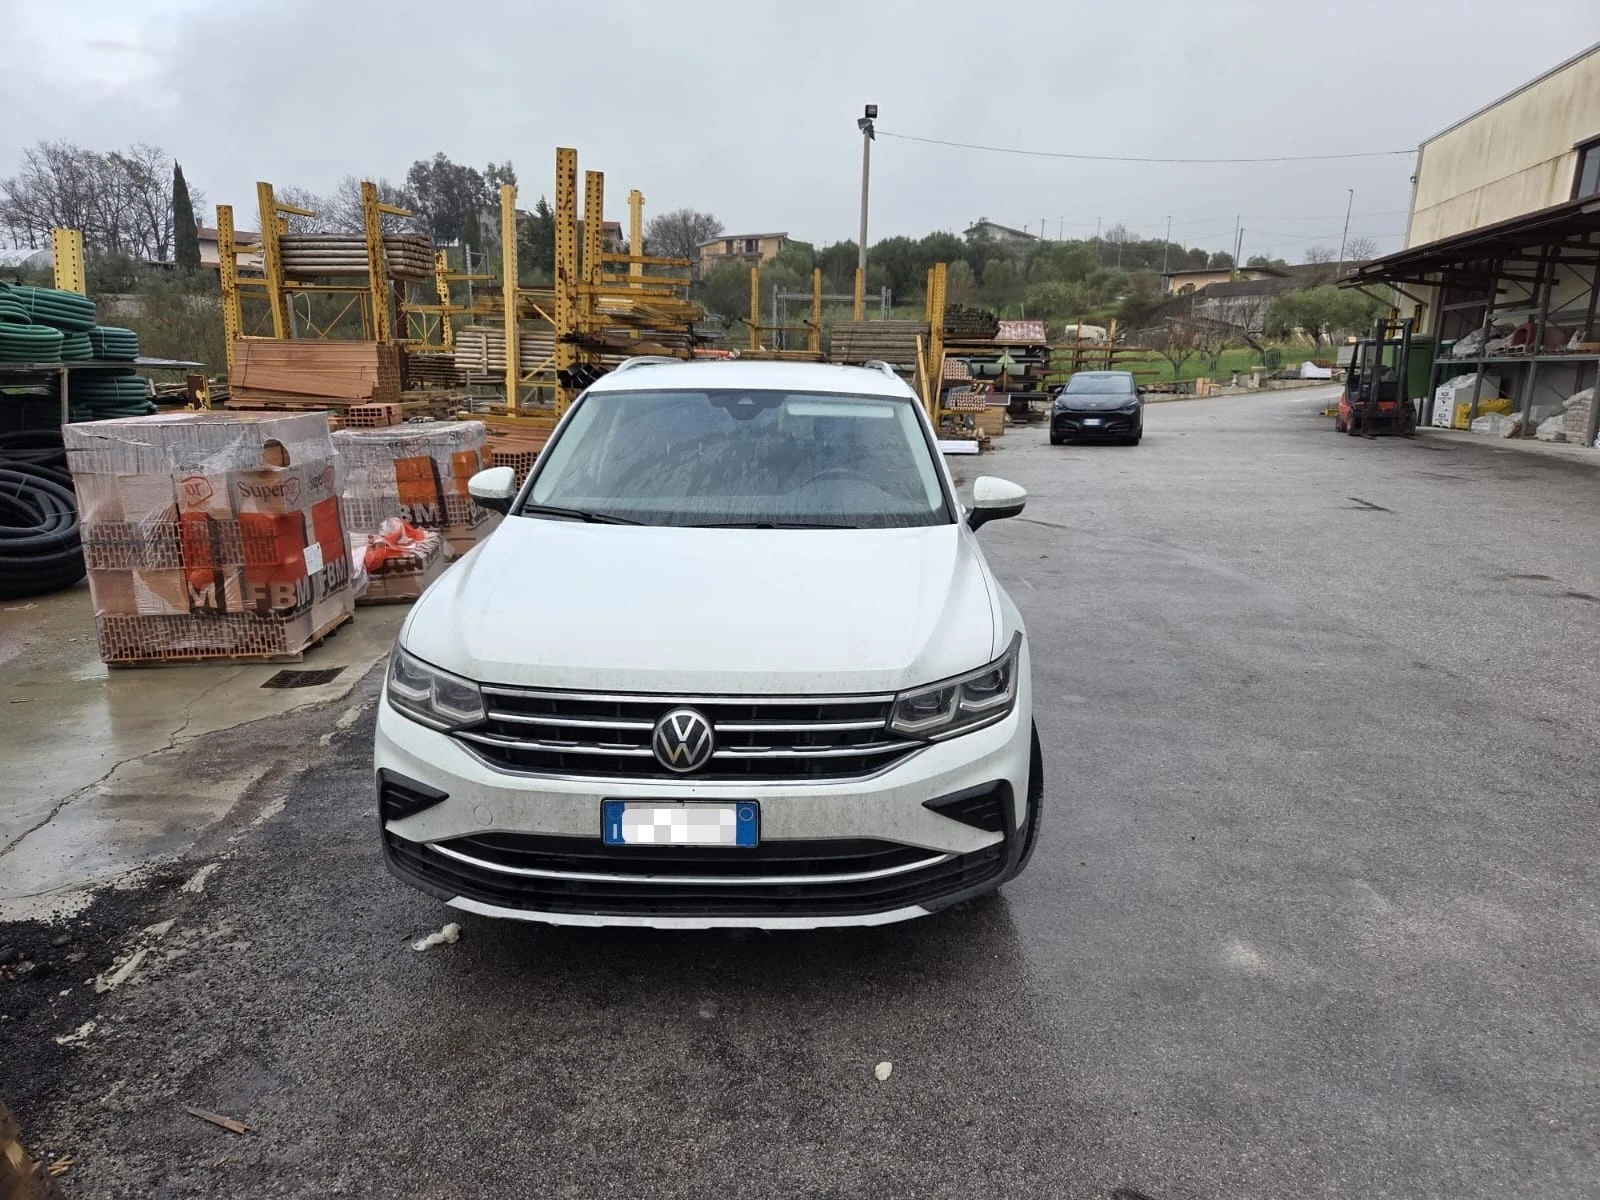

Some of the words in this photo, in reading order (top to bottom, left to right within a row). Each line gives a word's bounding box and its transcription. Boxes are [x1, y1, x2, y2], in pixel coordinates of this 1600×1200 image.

[237, 481, 285, 502] Super
[248, 576, 312, 610] FBM
[320, 555, 348, 598] FBM
